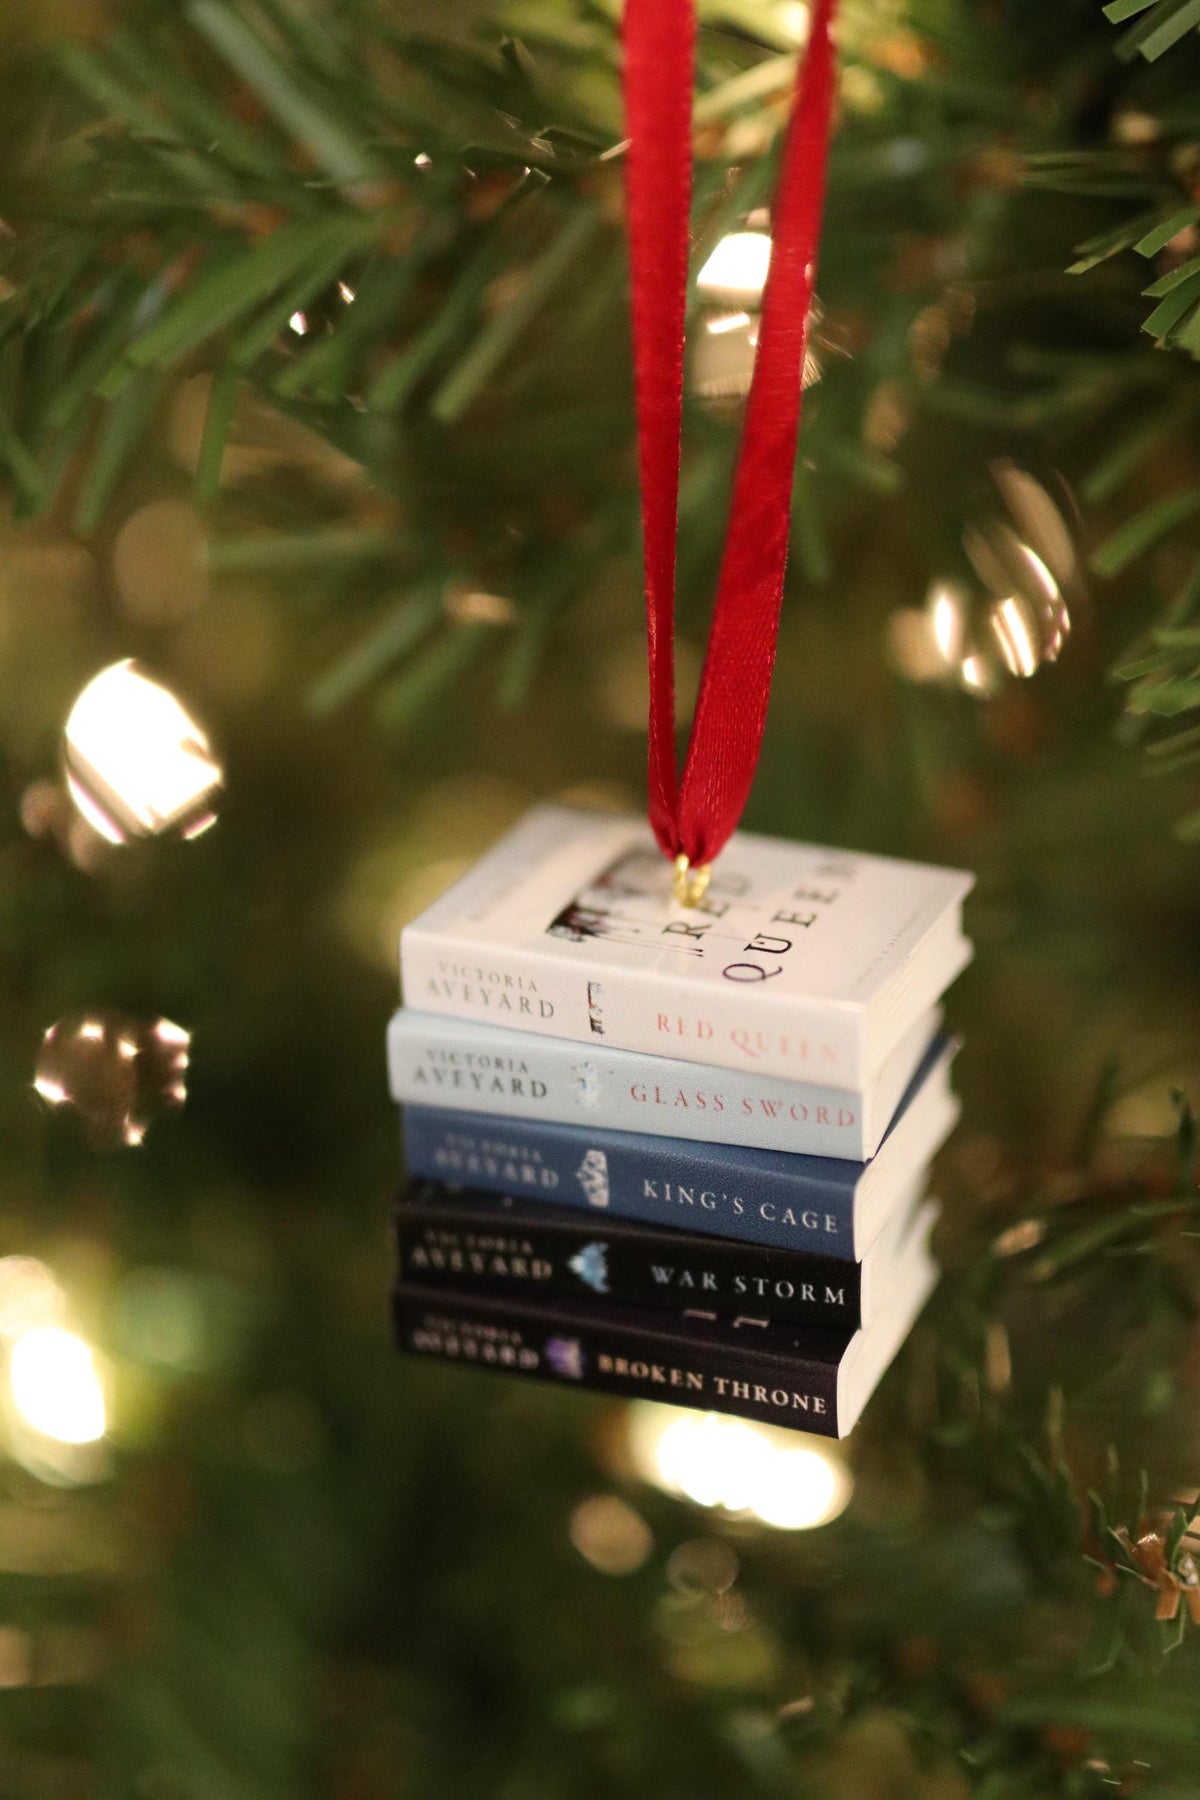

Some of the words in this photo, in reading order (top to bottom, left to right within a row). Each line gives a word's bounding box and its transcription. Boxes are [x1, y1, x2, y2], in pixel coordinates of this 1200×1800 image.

[722, 853, 857, 983] QUEEN
[439, 961, 537, 992] VICTORIA
[427, 979, 554, 1018] AVEYARD
[657, 1013, 714, 1040] RED
[730, 1028, 838, 1063] QUEEN
[414, 1066, 547, 1098] AVEYARD
[427, 1049, 528, 1073] VICTORIA
[630, 1084, 725, 1112] GLASS
[742, 1098, 855, 1127] SWORD
[643, 1179, 744, 1215] KING'S
[760, 1202, 838, 1234] CAGE
[651, 1265, 719, 1290] WAR
[734, 1275, 846, 1306] STORM
[598, 1353, 704, 1389] BROKEN
[713, 1376, 827, 1414] THRONE
